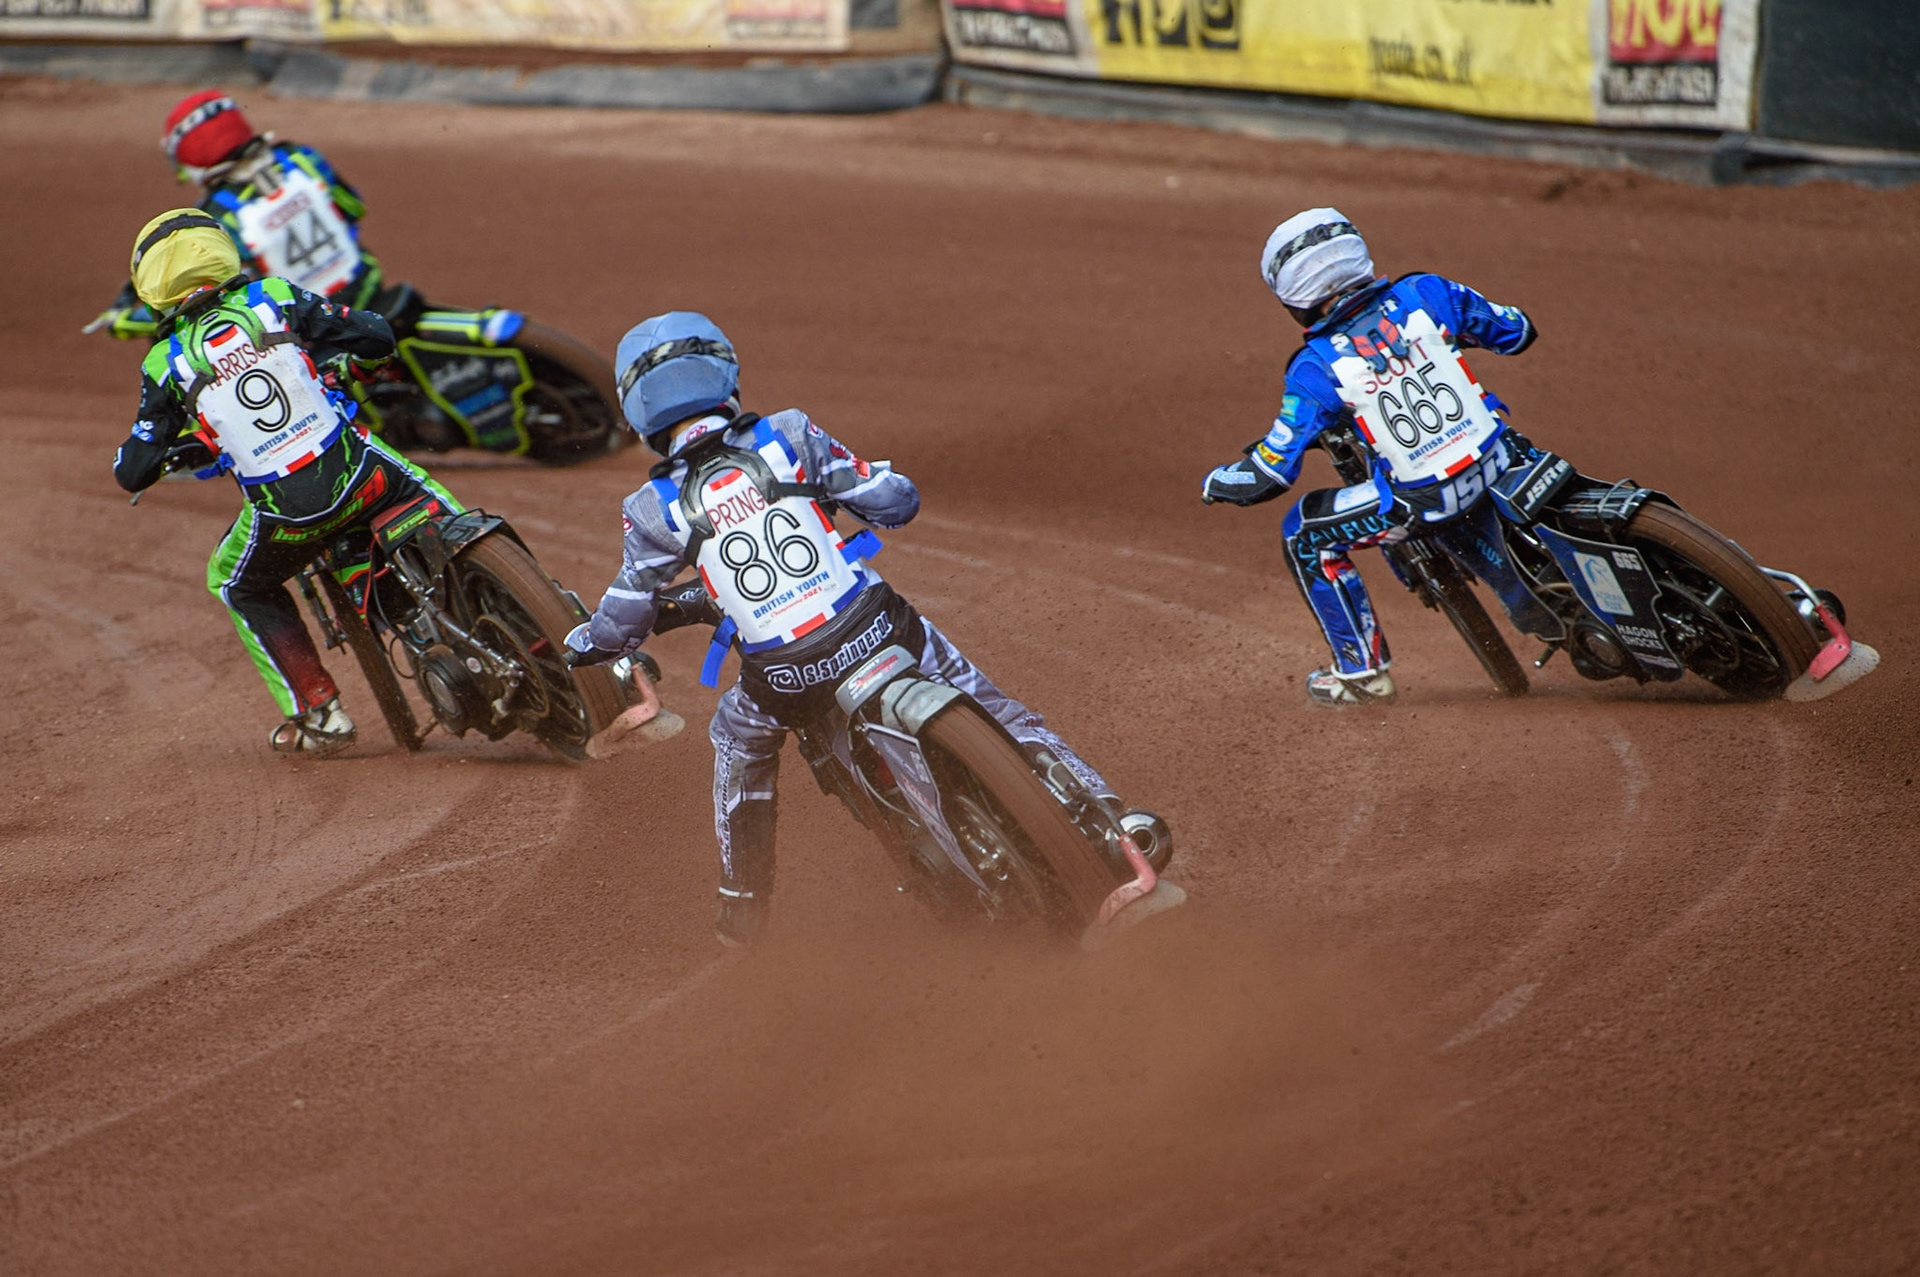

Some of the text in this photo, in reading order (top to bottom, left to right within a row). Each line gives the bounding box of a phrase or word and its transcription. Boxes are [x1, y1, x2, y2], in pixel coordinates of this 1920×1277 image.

[286, 209, 338, 267] 44
[235, 368, 291, 433] 9
[1378, 362, 1463, 448] 665
[252, 412, 319, 457] BRITISH YOUTH
[1408, 418, 1473, 461] BRITISH YOUTH
[1523, 471, 1558, 511] JSR
[719, 507, 819, 602] 86
[752, 570, 830, 619] BRITISH YOUTH
[1615, 623, 1658, 639] HAGON
[1621, 635, 1664, 650] SHOCKS
